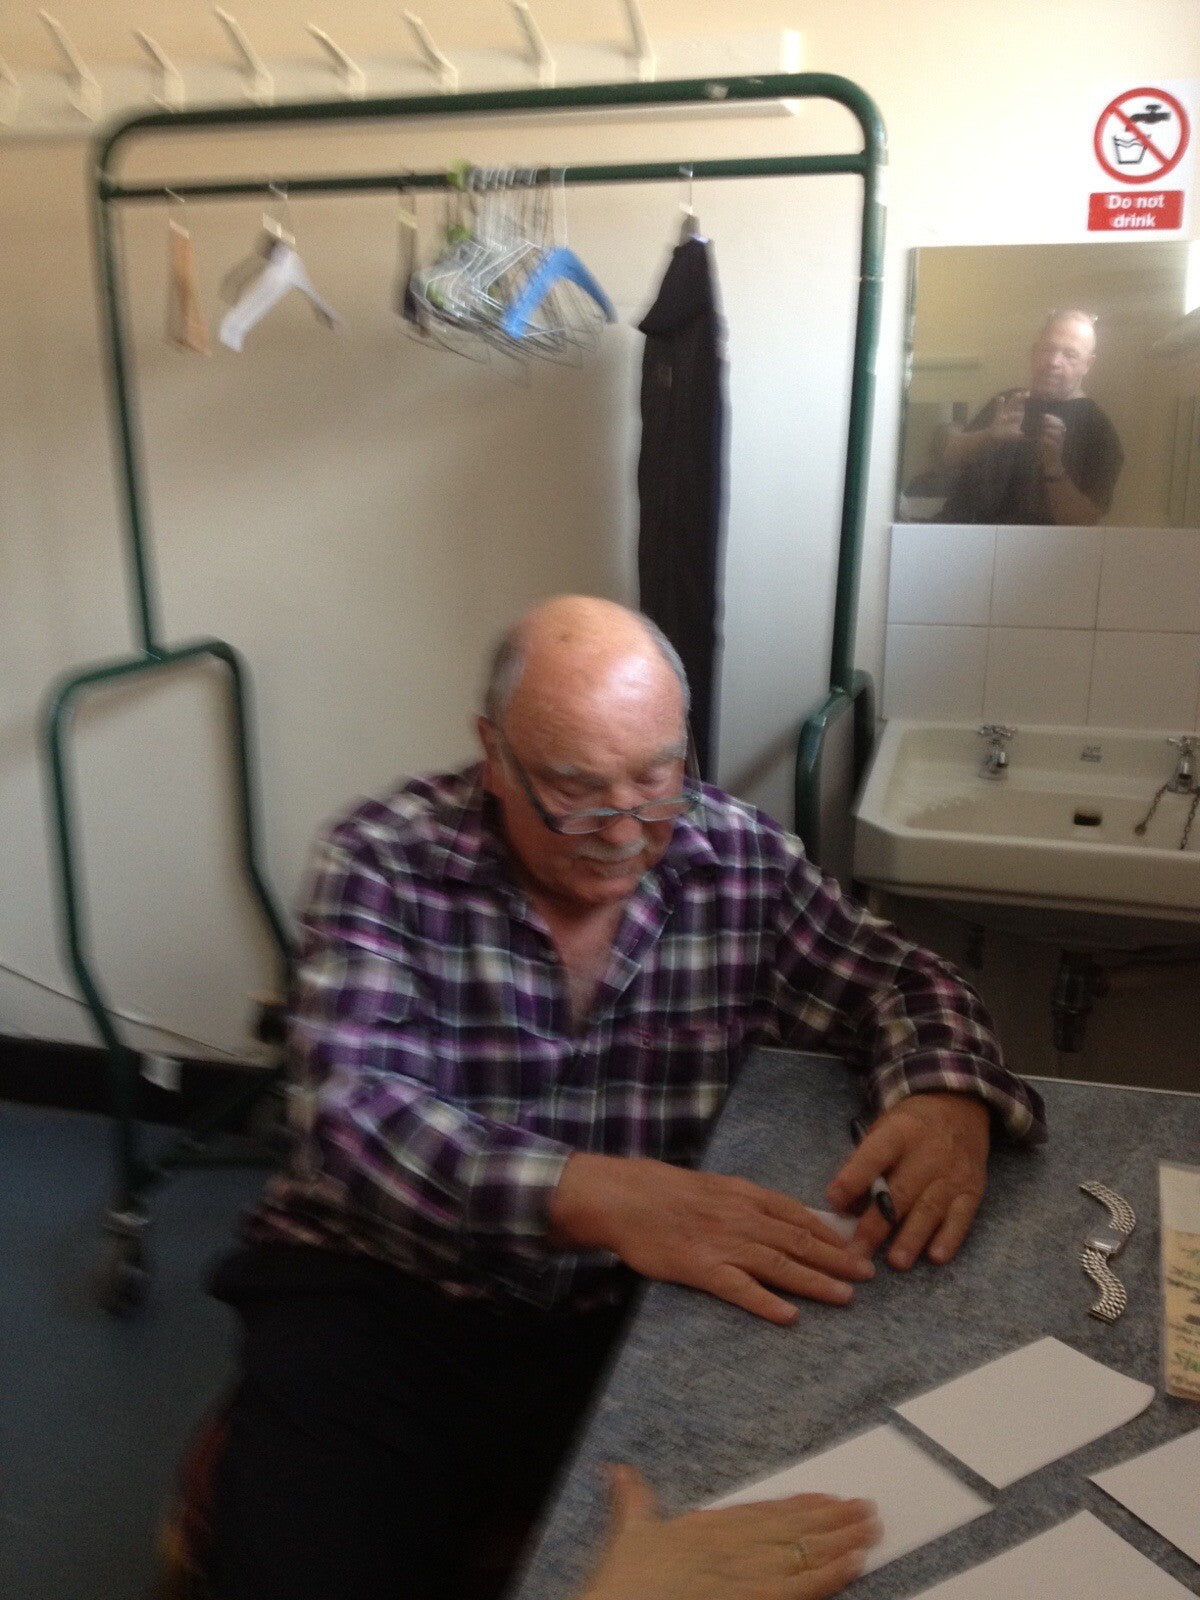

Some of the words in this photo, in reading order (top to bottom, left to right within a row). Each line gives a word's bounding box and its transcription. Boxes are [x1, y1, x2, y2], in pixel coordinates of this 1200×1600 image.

[1107, 195, 1132, 209] Do
[1136, 194, 1165, 208] not
[1112, 213, 1156, 228] drink
